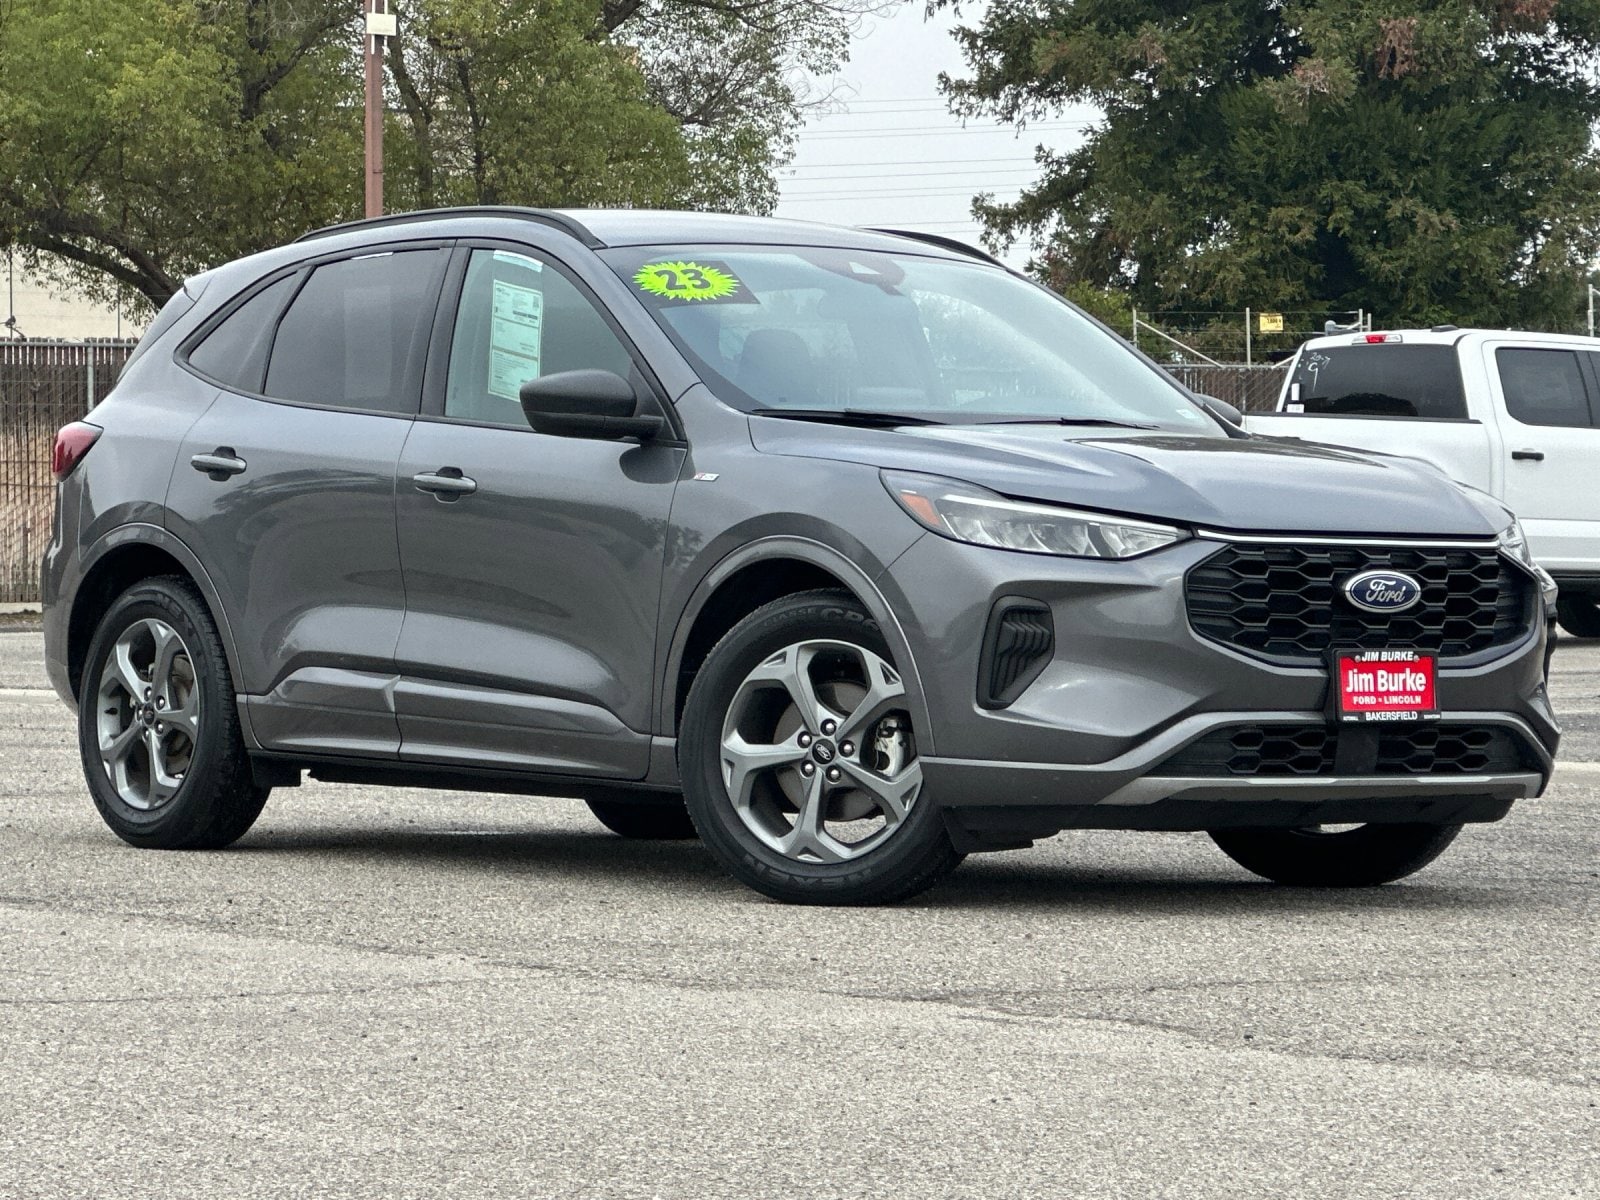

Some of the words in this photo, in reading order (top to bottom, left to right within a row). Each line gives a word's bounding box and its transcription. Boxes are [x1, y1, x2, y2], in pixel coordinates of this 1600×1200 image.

[654, 268, 711, 290] 23
[1365, 579, 1407, 602] Ford
[1362, 651, 1379, 661] JIM
[1381, 651, 1414, 661] BURKE
[1346, 668, 1374, 692] Jim
[1377, 668, 1426, 692] Burke
[1353, 696, 1377, 705] FORD
[1384, 696, 1421, 705] LINCOLN
[1365, 711, 1418, 721] BAKERSFIELD
